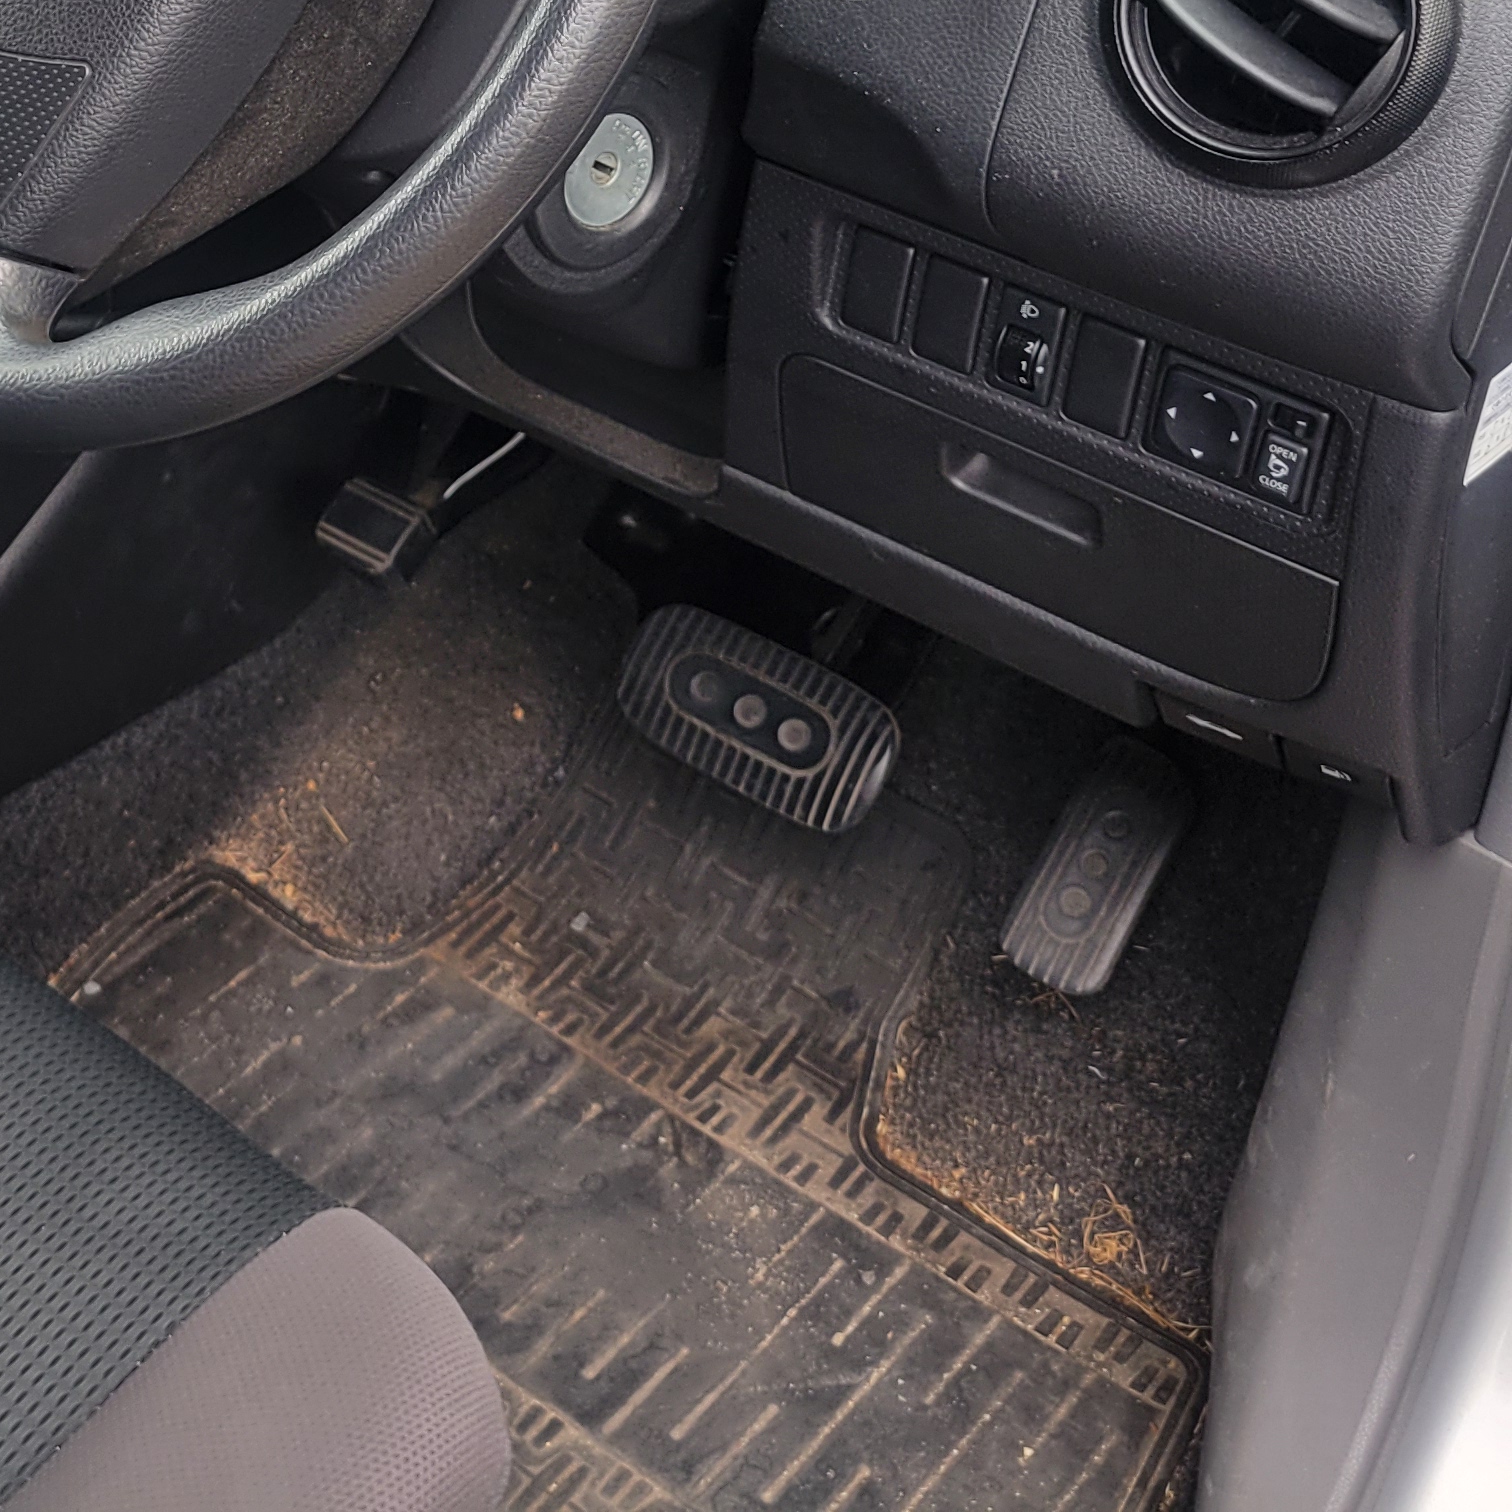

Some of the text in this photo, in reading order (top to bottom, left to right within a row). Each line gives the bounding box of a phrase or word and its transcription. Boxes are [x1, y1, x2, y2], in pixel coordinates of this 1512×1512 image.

[1023, 341, 1035, 355] 2
[1020, 360, 1028, 373] 1
[1268, 443, 1298, 462] OPEN
[1258, 475, 1289, 495] CLOSE
